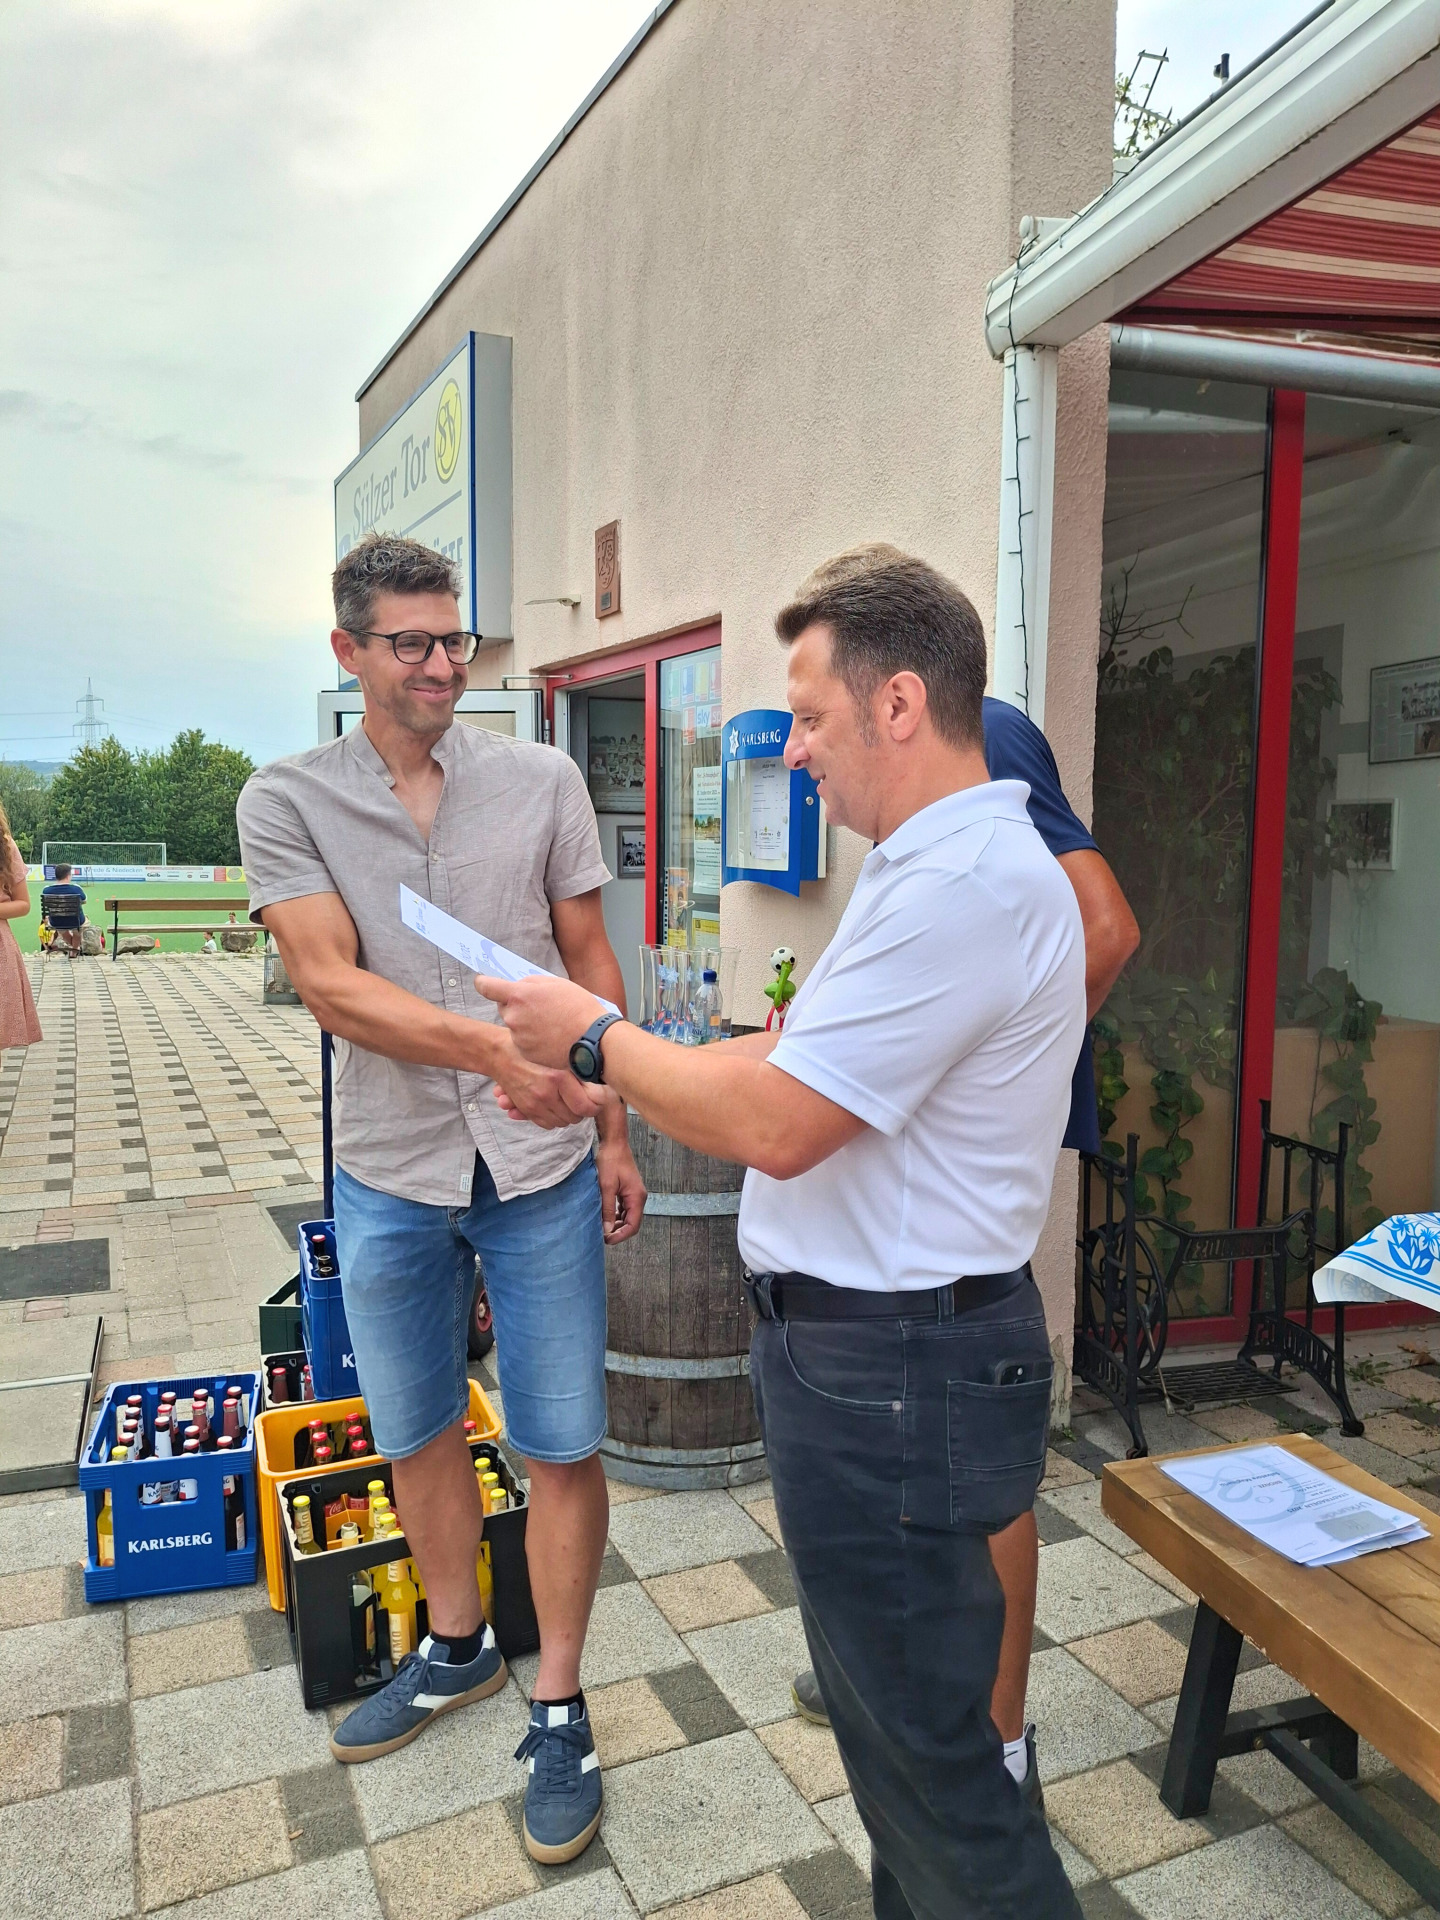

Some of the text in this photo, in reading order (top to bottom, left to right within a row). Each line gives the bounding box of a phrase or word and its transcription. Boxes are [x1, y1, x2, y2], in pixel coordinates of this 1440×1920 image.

[353, 434, 430, 538] Sülzer Tor
[697, 711, 710, 728] sky
[741, 729, 781, 747] KARLSBERG
[128, 1532, 213, 1554] KARLSBERG
